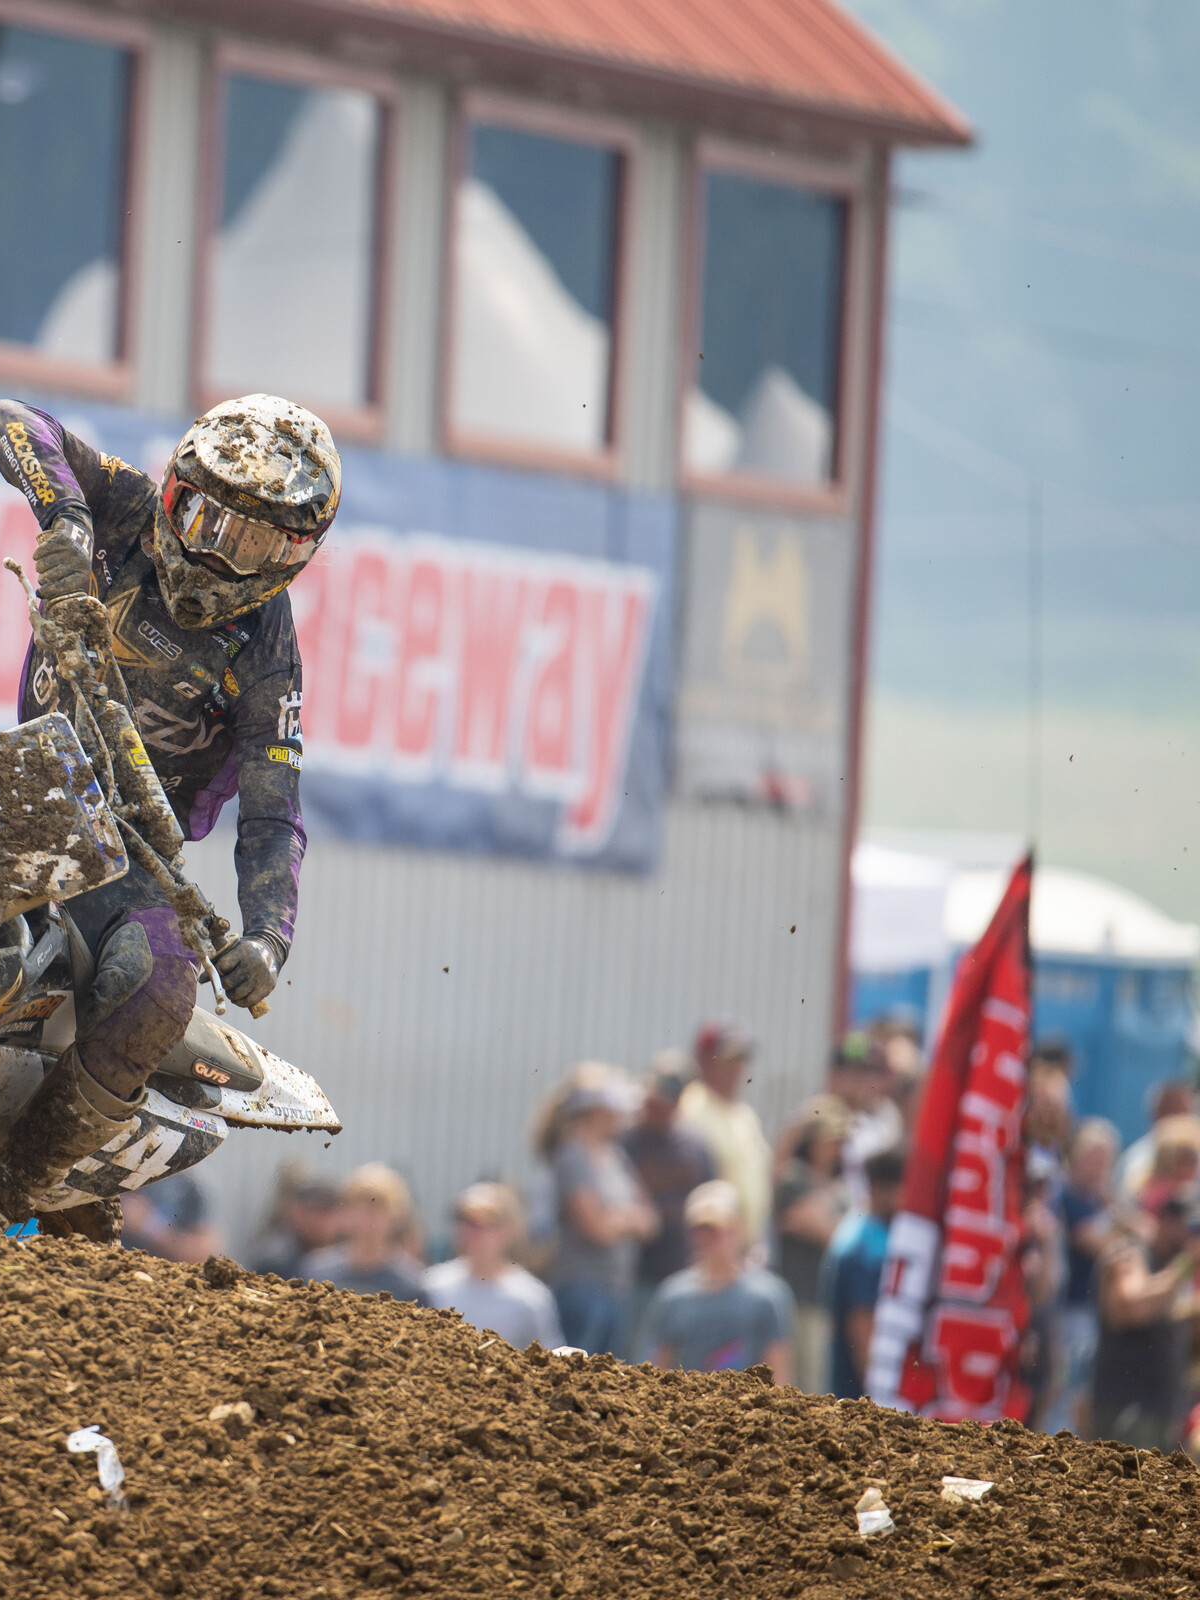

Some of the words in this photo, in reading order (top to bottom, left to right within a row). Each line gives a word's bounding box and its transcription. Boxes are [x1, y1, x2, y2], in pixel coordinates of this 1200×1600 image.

[0, 434, 20, 474] ENERGY
[6, 422, 56, 507] ROCKSTAR
[138, 620, 183, 661] WPS
[194, 1061, 231, 1085] GUTS
